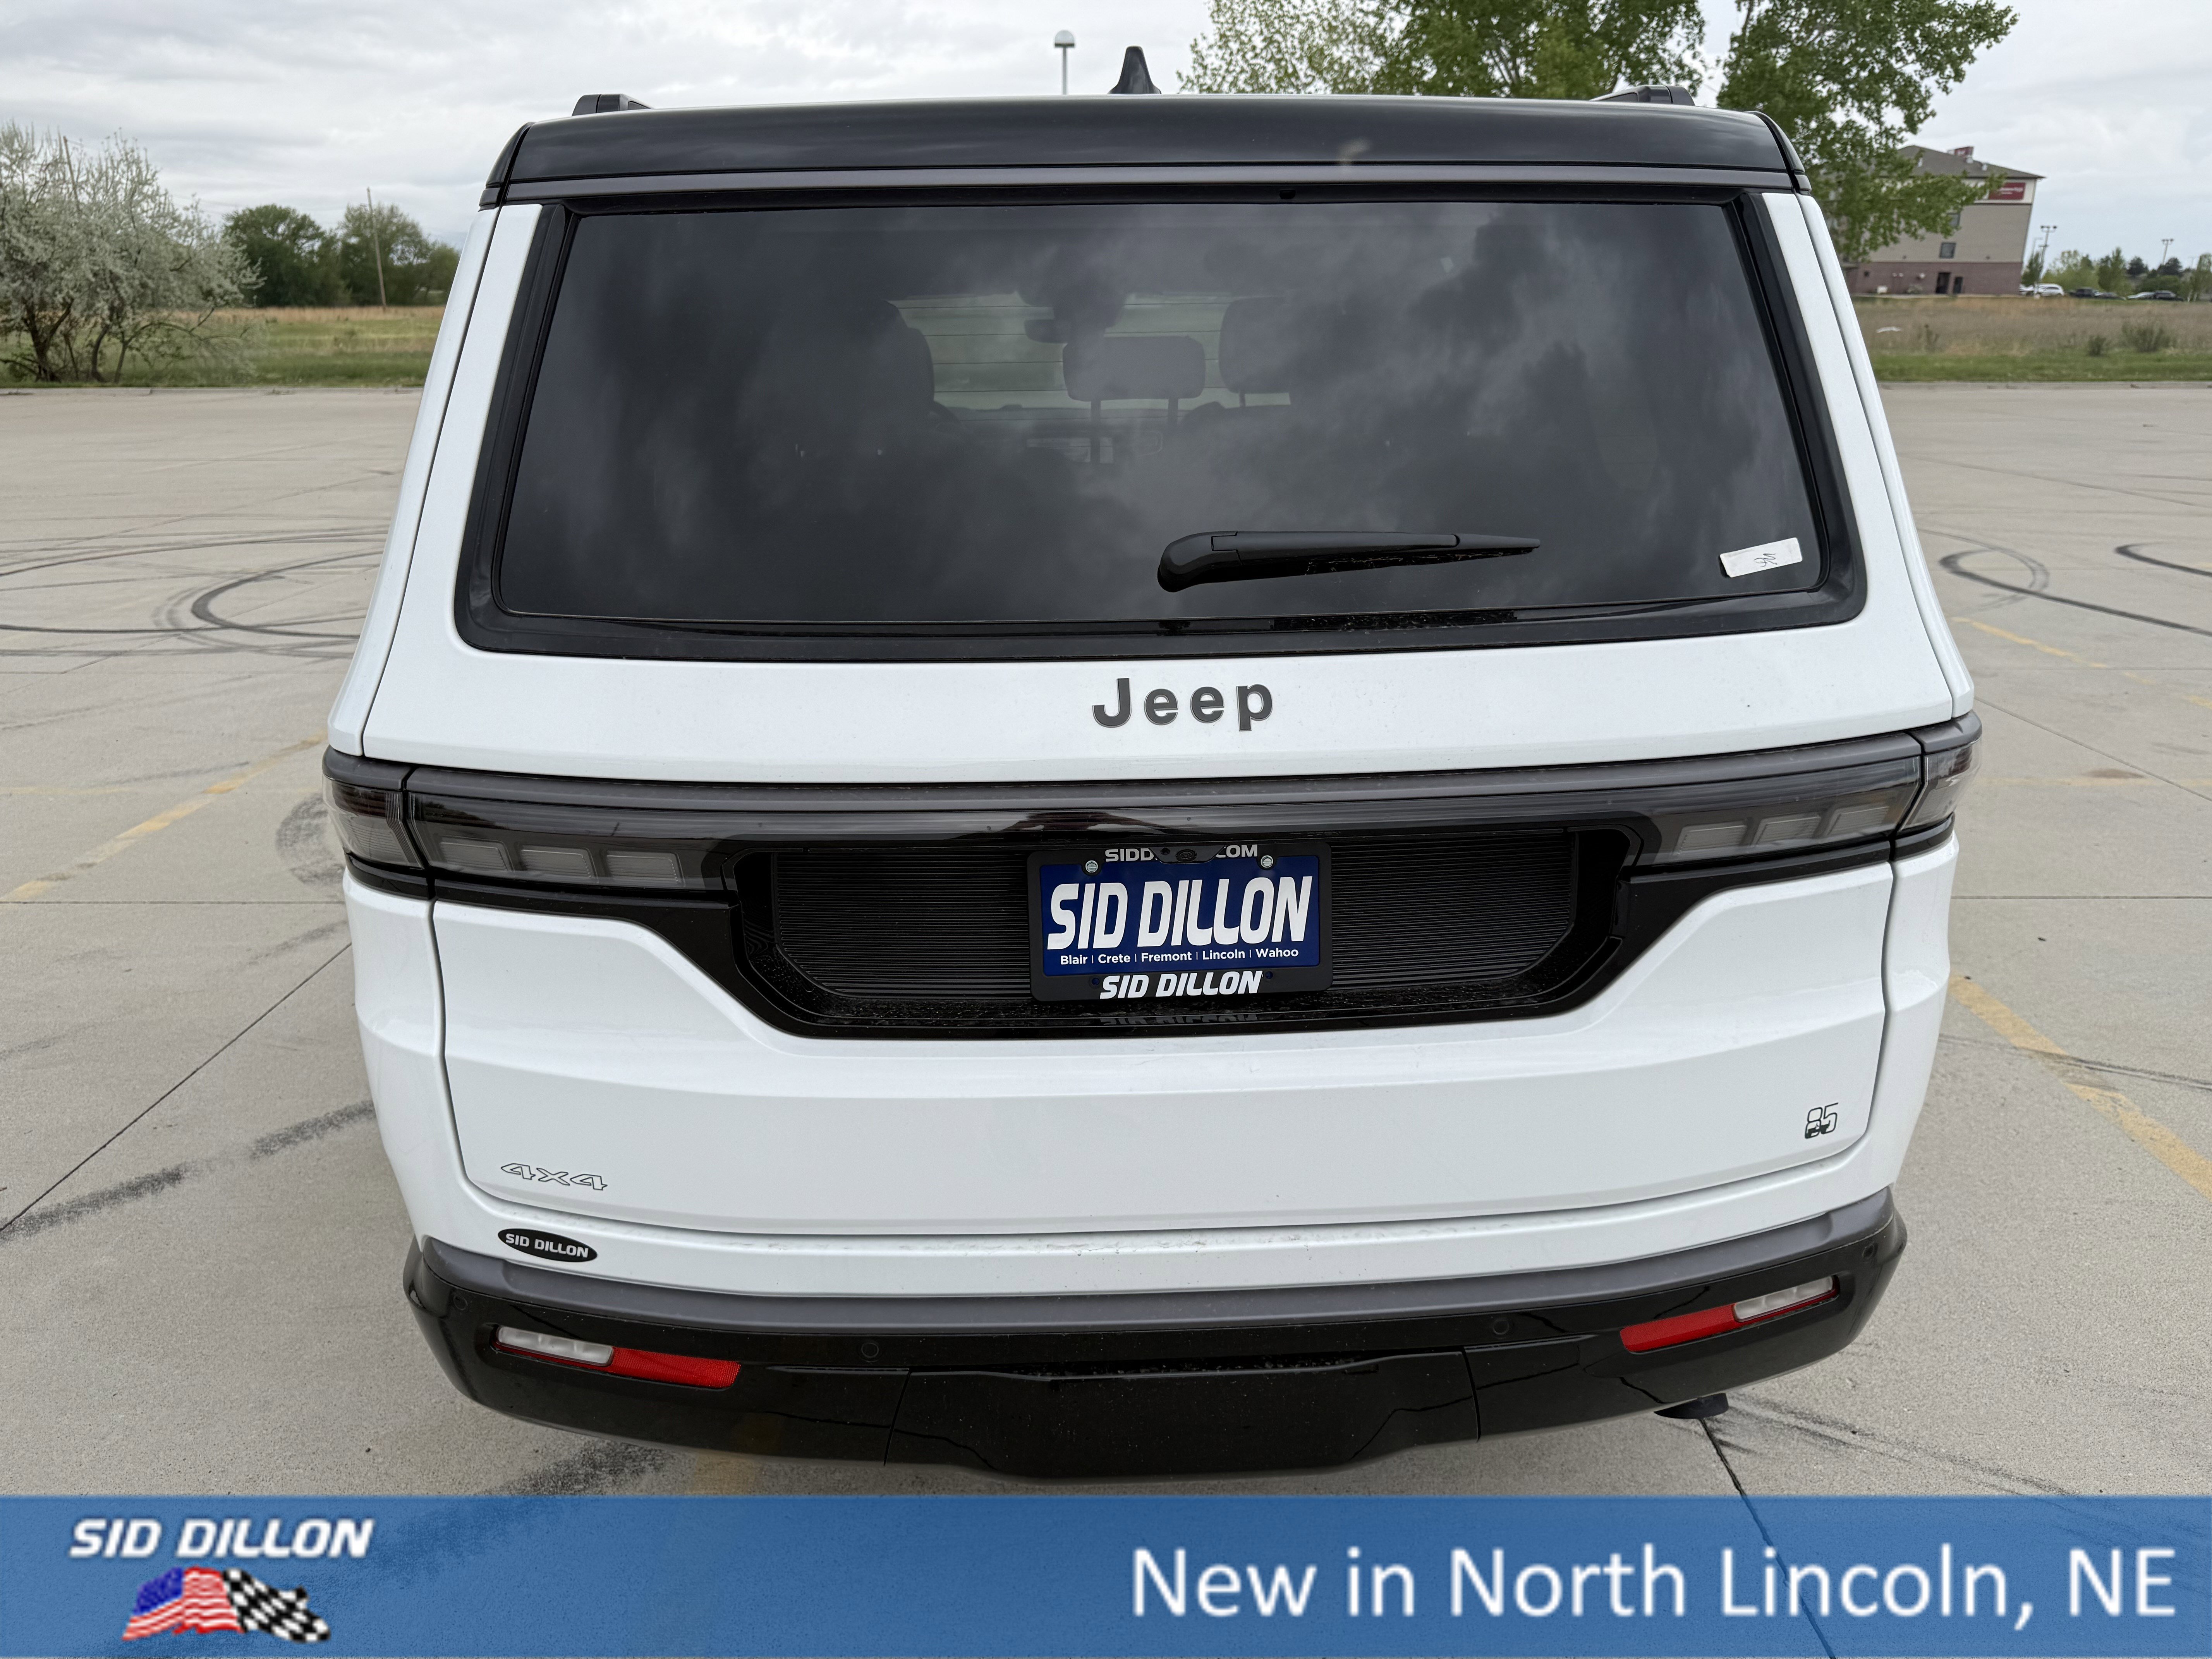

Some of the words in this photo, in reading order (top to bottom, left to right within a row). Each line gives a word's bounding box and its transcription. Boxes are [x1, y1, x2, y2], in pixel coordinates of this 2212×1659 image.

[1092, 678, 1273, 732] Jeep
[1047, 883, 1128, 950] SID
[1137, 876, 1313, 947] DILLON
[1060, 955, 1088, 965] Blair
[1098, 954, 1131, 963] Crete
[1141, 951, 1192, 962] Fremont
[1202, 949, 1245, 960] Lincoln
[1255, 948, 1299, 958] Wahoo
[1099, 974, 1149, 999] SID
[1155, 970, 1263, 997] DILLON
[506, 1233, 530, 1247] SID
[534, 1239, 589, 1258] DILLON
